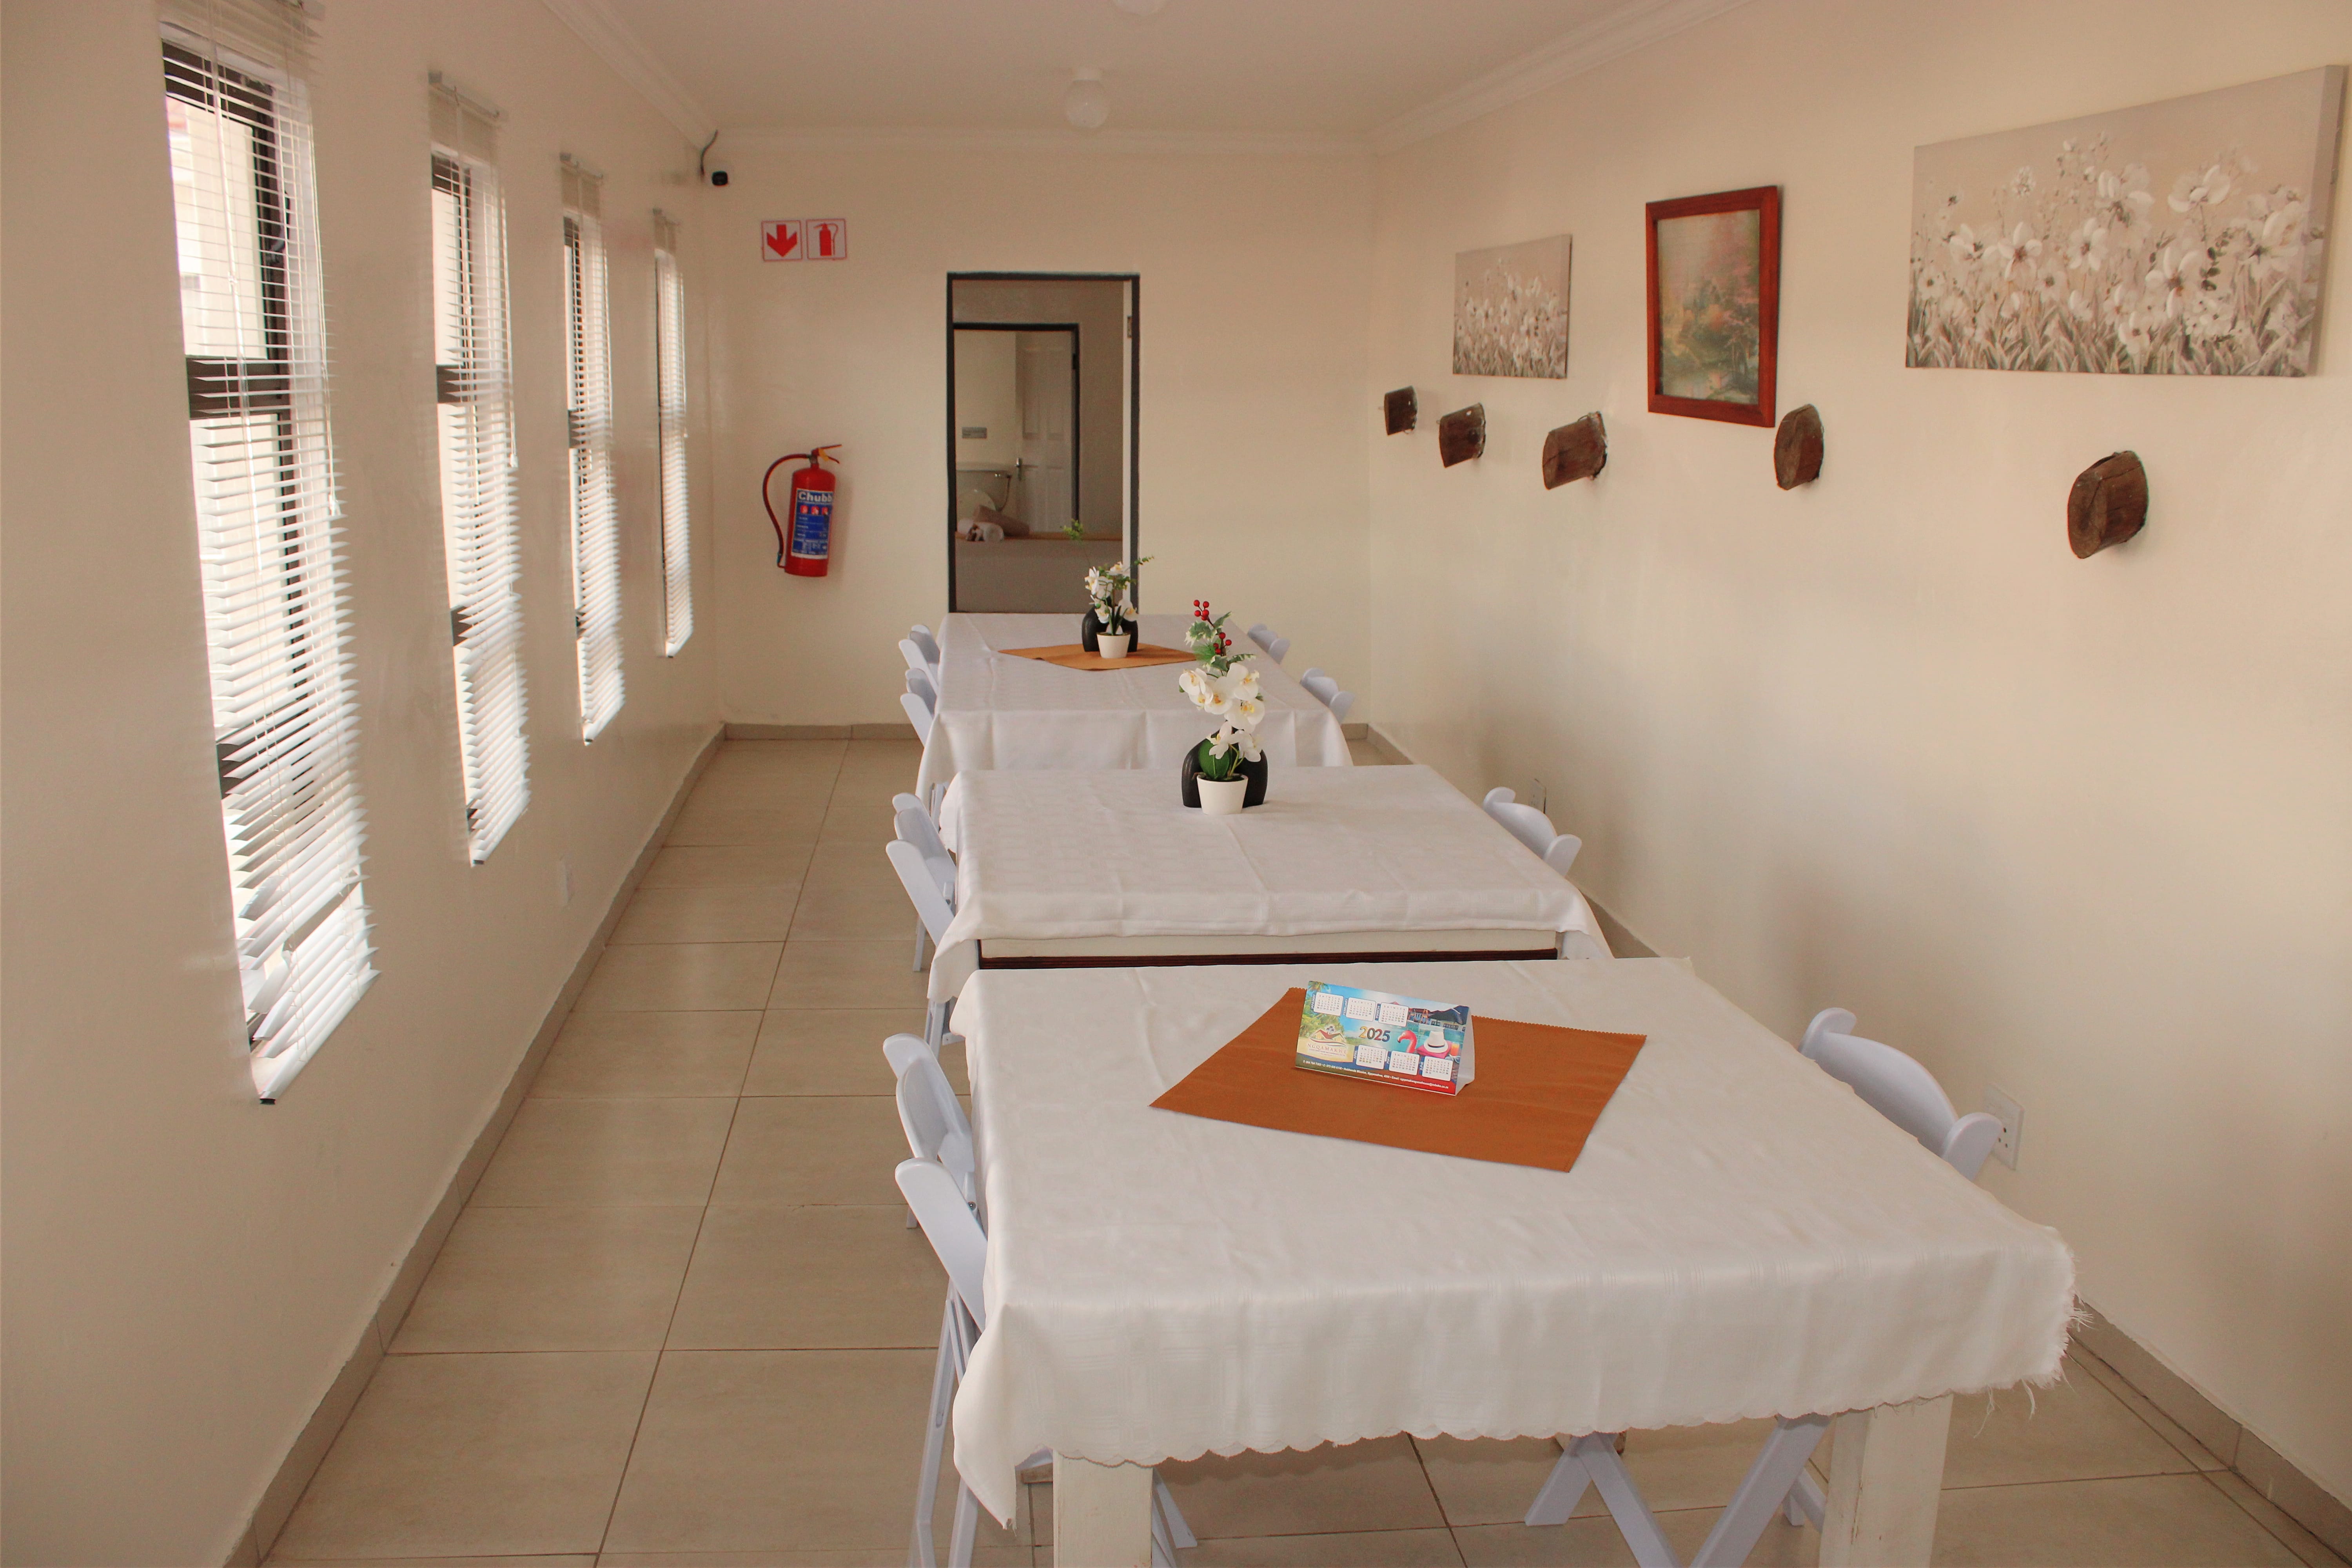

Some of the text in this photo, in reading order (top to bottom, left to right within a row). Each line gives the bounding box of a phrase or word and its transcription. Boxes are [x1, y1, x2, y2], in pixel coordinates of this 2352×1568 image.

[799, 491, 832, 502] Chubb
[1359, 1026, 1391, 1042] 2025
[1307, 1044, 1347, 1054] NGQAMAKWE
